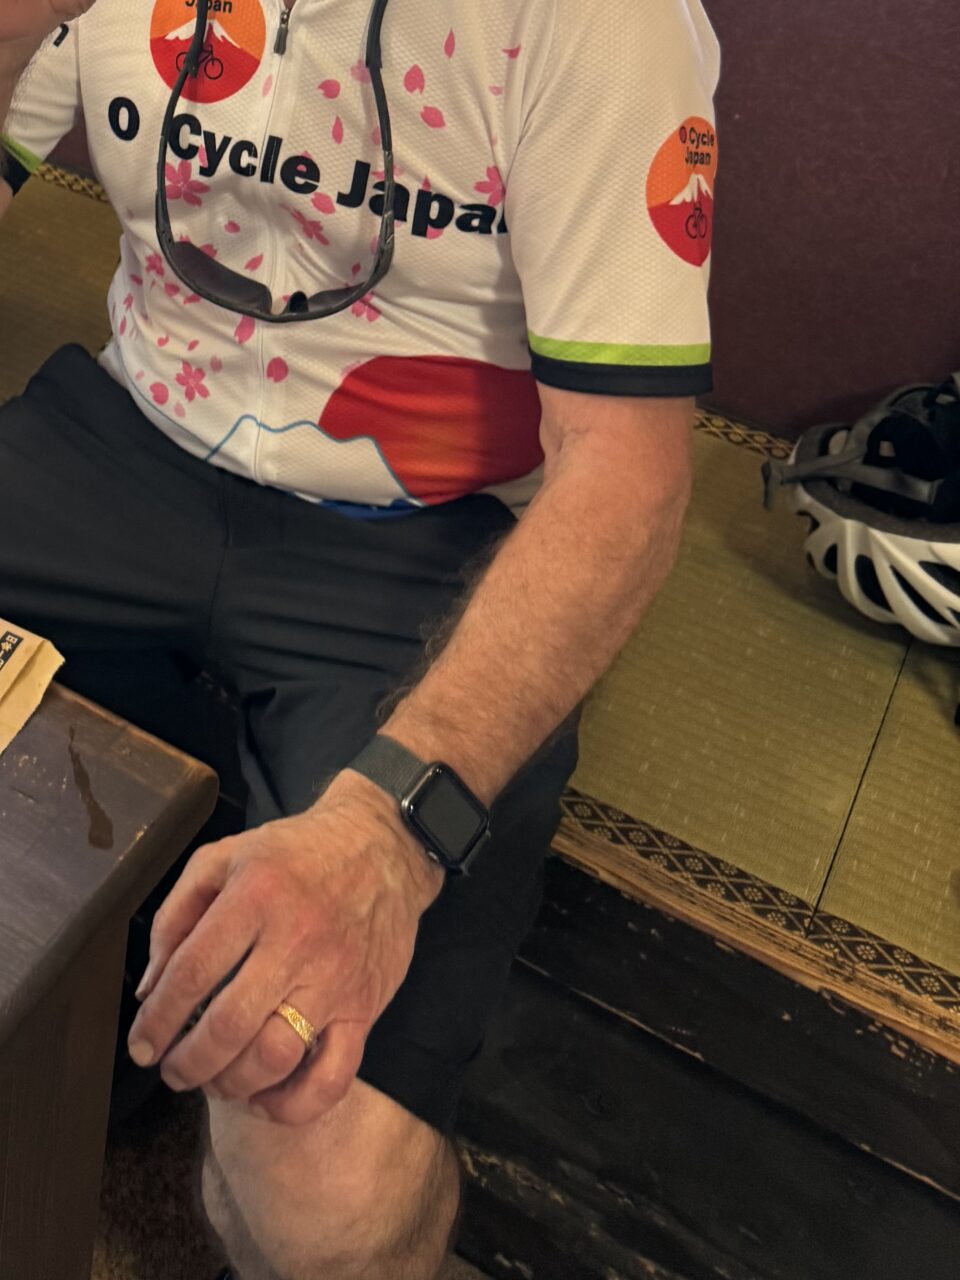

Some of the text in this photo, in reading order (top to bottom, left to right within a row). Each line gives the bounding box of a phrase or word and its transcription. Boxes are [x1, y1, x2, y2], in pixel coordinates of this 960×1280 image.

[689, 127, 715, 149] Cycle
[166, 113, 320, 195] Cycle
[685, 146, 712, 169] Japan
